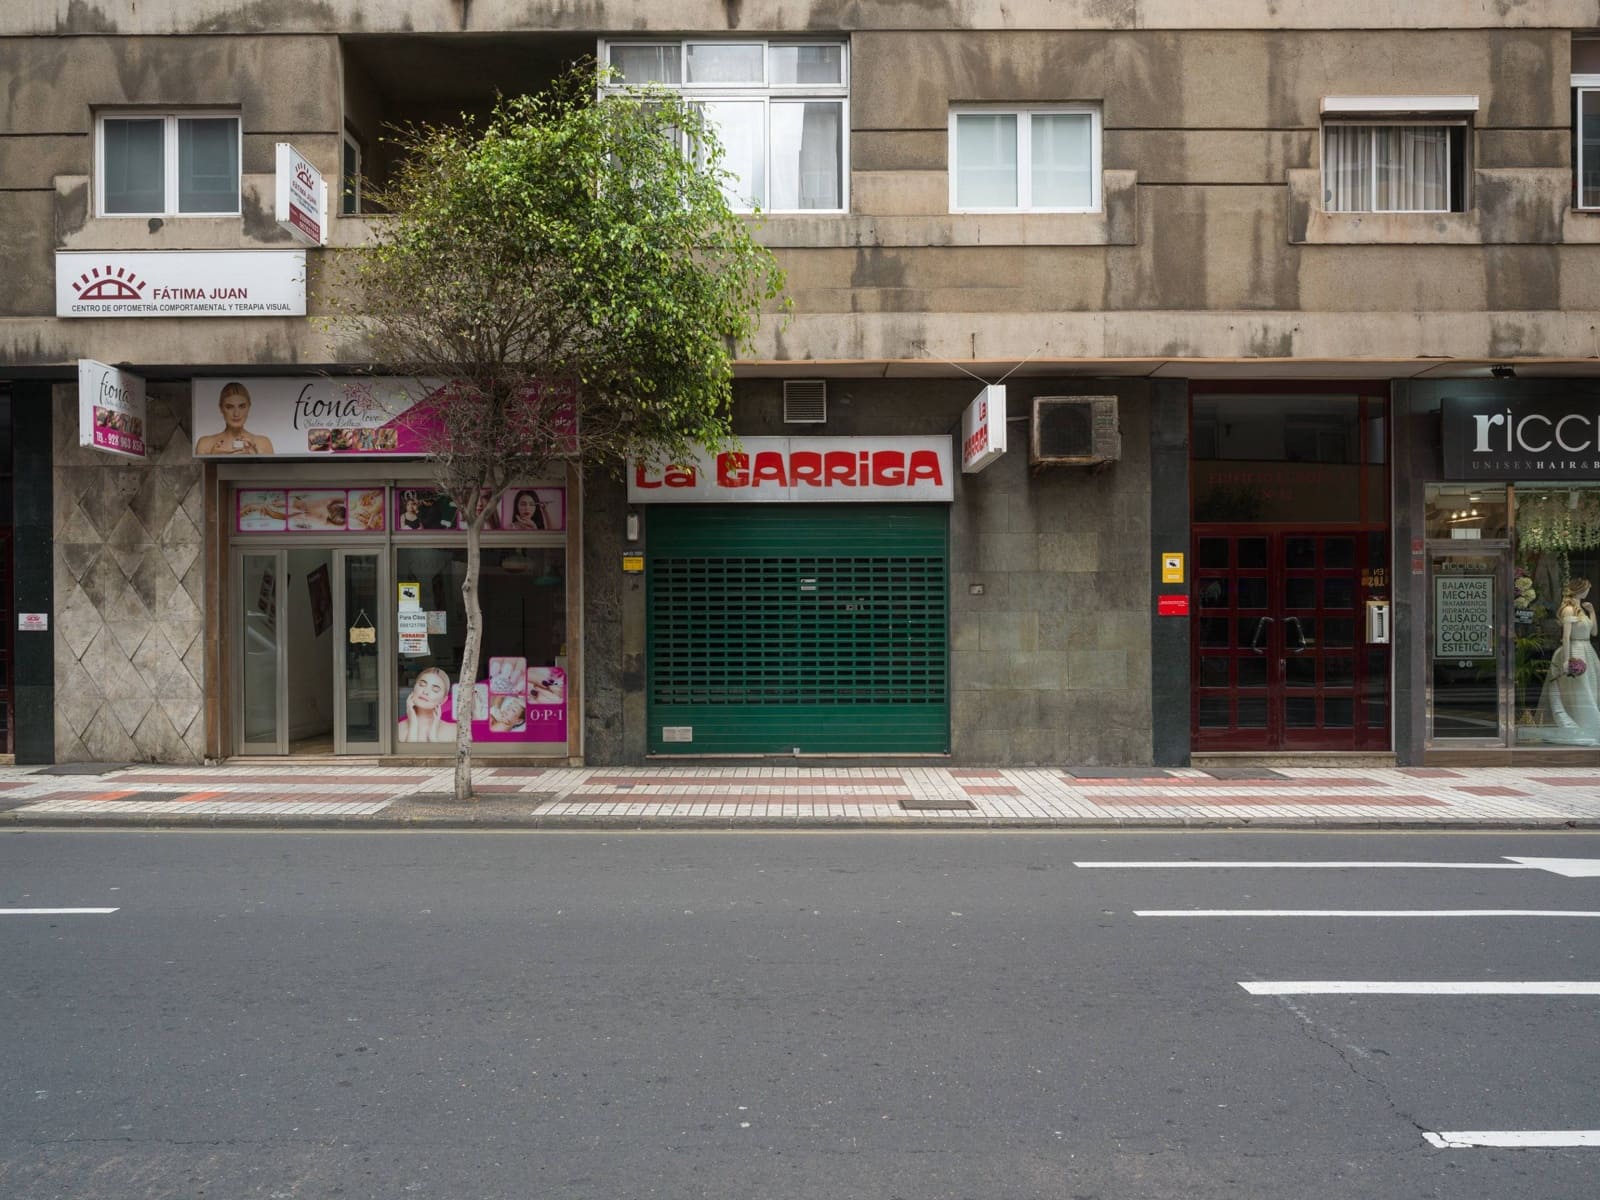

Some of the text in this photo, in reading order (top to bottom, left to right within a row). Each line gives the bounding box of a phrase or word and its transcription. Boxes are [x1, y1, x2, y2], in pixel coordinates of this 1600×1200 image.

[153, 285, 248, 300] FÁTIMA JUAN
[71, 303, 291, 312] CENTRO DE OPTOMETRÍA COMPORTAMENTAL Y TERAPIA VISUAL
[99, 371, 130, 406] fiona
[293, 383, 361, 430] fiona
[635, 456, 696, 489] La
[1442, 582, 1487, 590] BALAYAGE
[1442, 590, 1488, 600] MECHAS
[1442, 614, 1488, 623] ALISADO
[1441, 631, 1488, 642] COLOR
